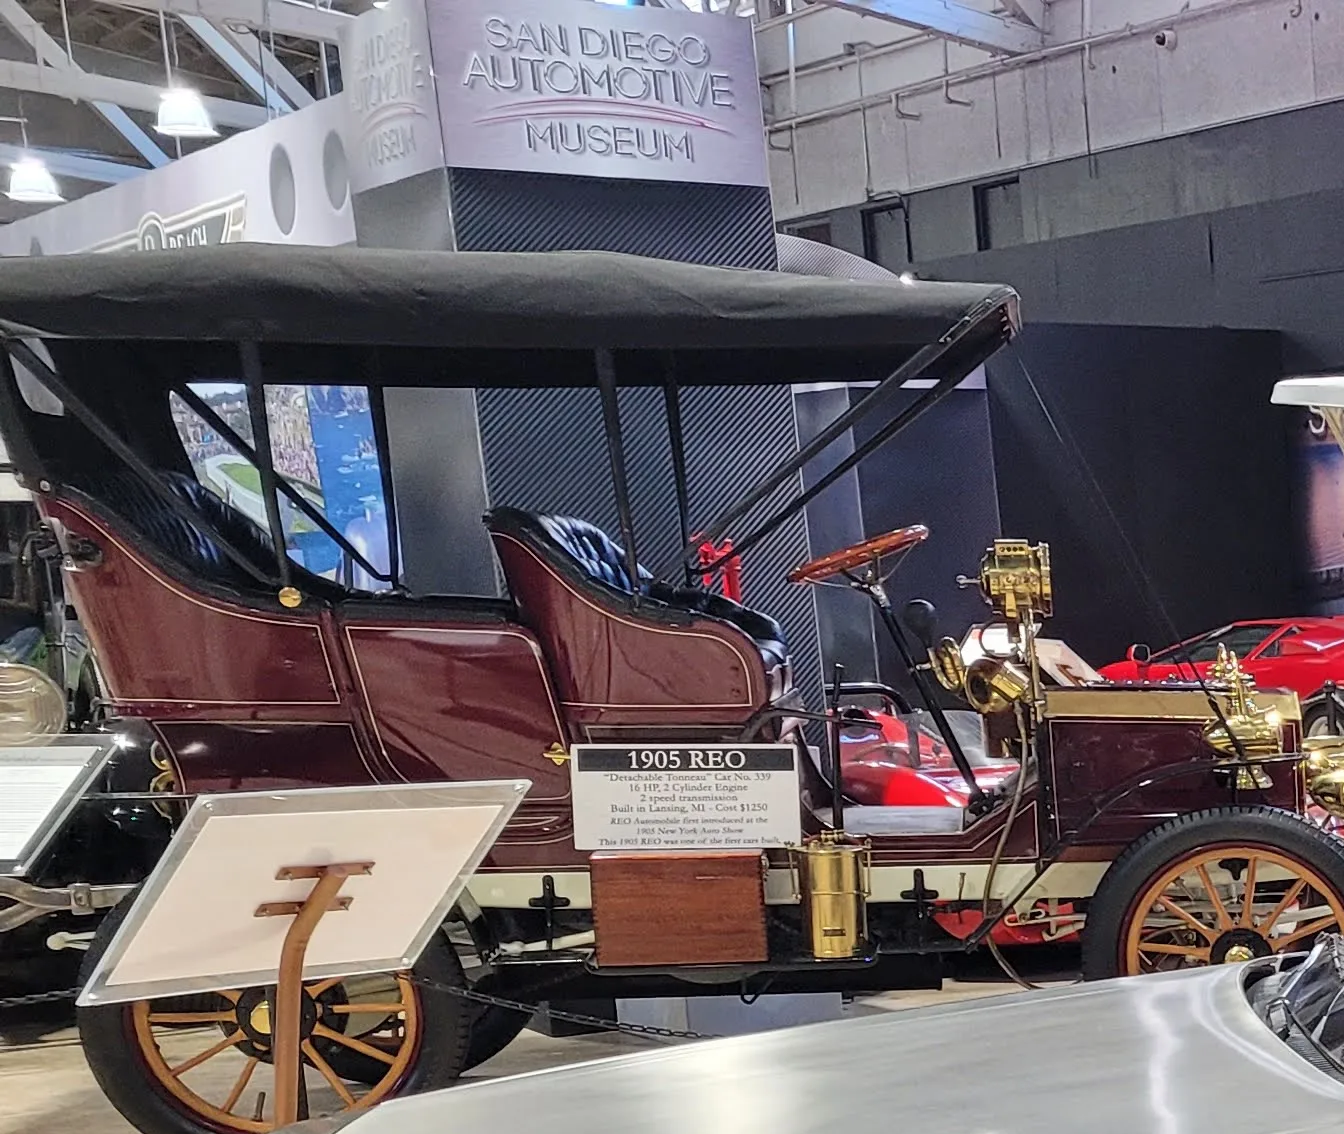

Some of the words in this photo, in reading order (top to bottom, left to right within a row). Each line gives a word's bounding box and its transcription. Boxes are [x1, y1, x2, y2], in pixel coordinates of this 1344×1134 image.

[485, 18, 571, 57] SAN
[578, 27, 712, 67] DIEGO
[463, 52, 736, 109] AUTOMOTIVE
[524, 119, 695, 163] MUSEUM
[627, 751, 681, 769] 1905
[688, 751, 746, 769] REO
[714, 773, 731, 781] Car
[754, 772, 771, 780] 339
[630, 784, 640, 792] 16
[672, 783, 712, 793] Cylinder
[716, 784, 748, 792] Engine
[649, 794, 676, 804] speed
[611, 804, 633, 812] Built
[716, 803, 738, 812] Cost
[740, 803, 768, 812] $1250
[678, 827, 697, 835] York
[598, 838, 616, 846] This
